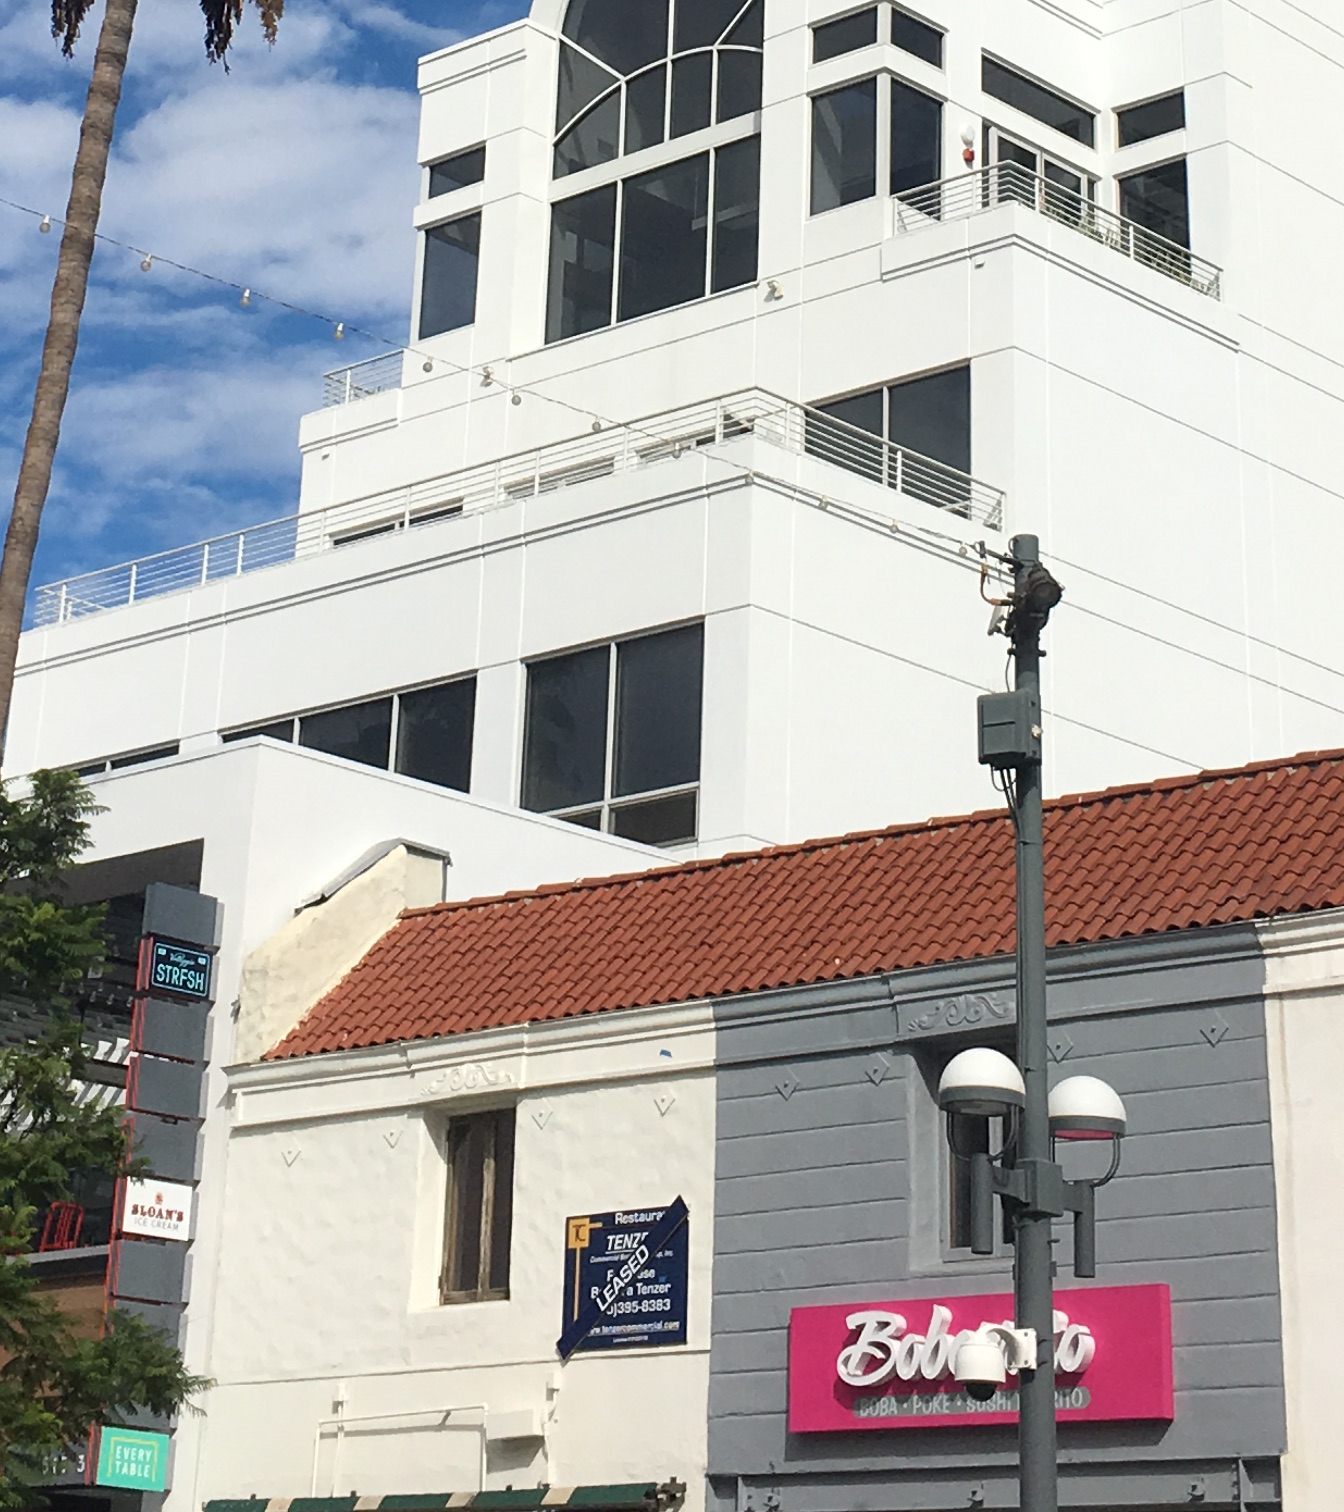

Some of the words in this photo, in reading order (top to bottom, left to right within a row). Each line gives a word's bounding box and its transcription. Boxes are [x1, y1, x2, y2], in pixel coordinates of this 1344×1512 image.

[156, 963, 205, 991] STRFSH
[131, 1203, 184, 1222] SLOAN'S
[614, 1211, 666, 1225] Restaura
[607, 1232, 649, 1250] TENZ
[596, 1244, 650, 1312] LEASED
[636, 1282, 671, 1296] Tenzer
[859, 1396, 898, 1418] BOBA
[912, 1394, 951, 1415] POKE
[116, 1445, 152, 1462] EVERY
[115, 1460, 151, 1478] TABLE
